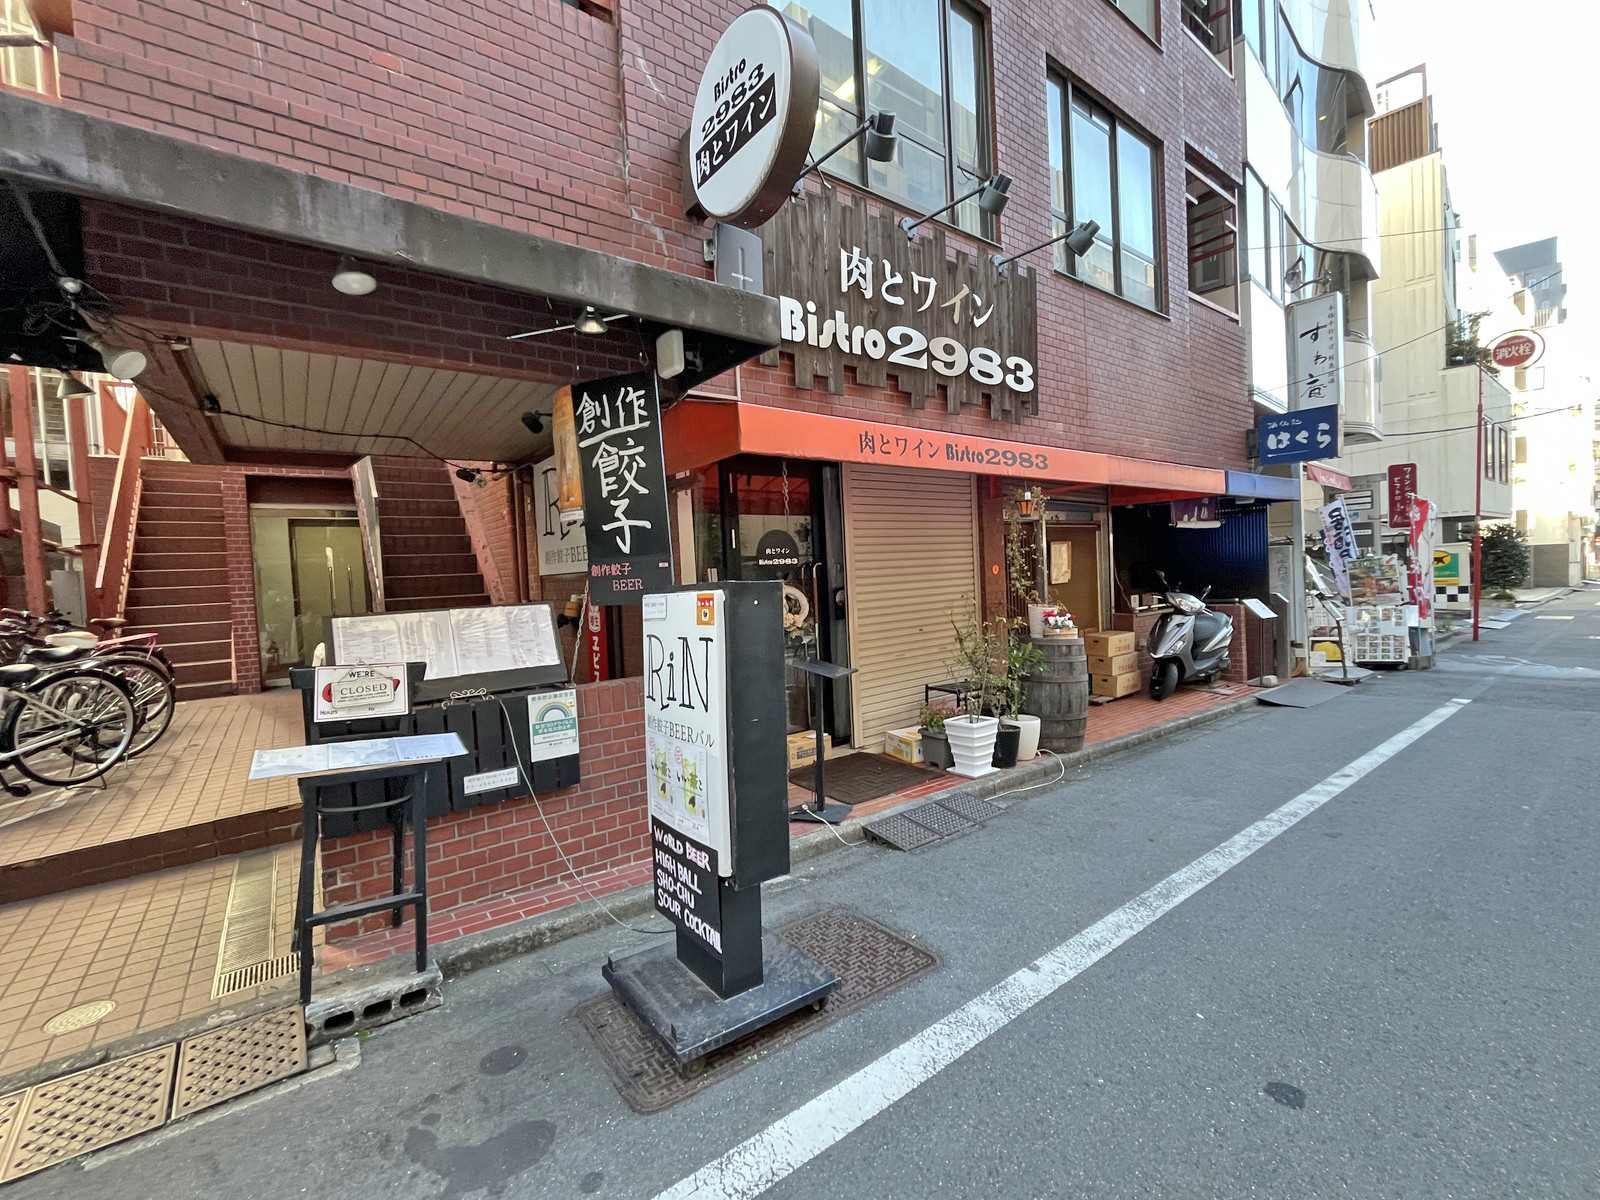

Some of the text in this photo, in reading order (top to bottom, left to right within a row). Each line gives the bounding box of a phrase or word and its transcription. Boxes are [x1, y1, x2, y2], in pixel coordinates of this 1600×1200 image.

[714, 58, 746, 103] Bistro
[702, 63, 765, 142] 2983
[696, 86, 774, 184] 肉とワイン
[840, 245, 994, 328] 肉とワイン
[1495, 342, 1533, 361] 消火栓
[576, 386, 650, 435] 創作
[858, 430, 1049, 470] 肉とワイン Bistro2983
[1266, 422, 1332, 450] はくら
[592, 437, 652, 555] 餃子
[591, 562, 632, 577] 創作餃子
[612, 578, 644, 592] BEER
[340, 683, 388, 696] CLOSED
[655, 847, 703, 895] HIGH BALL
[685, 841, 712, 873] BEER
[656, 868, 695, 909] SHO-CHU
[657, 888, 723, 954] SOUR COCKTAIL
